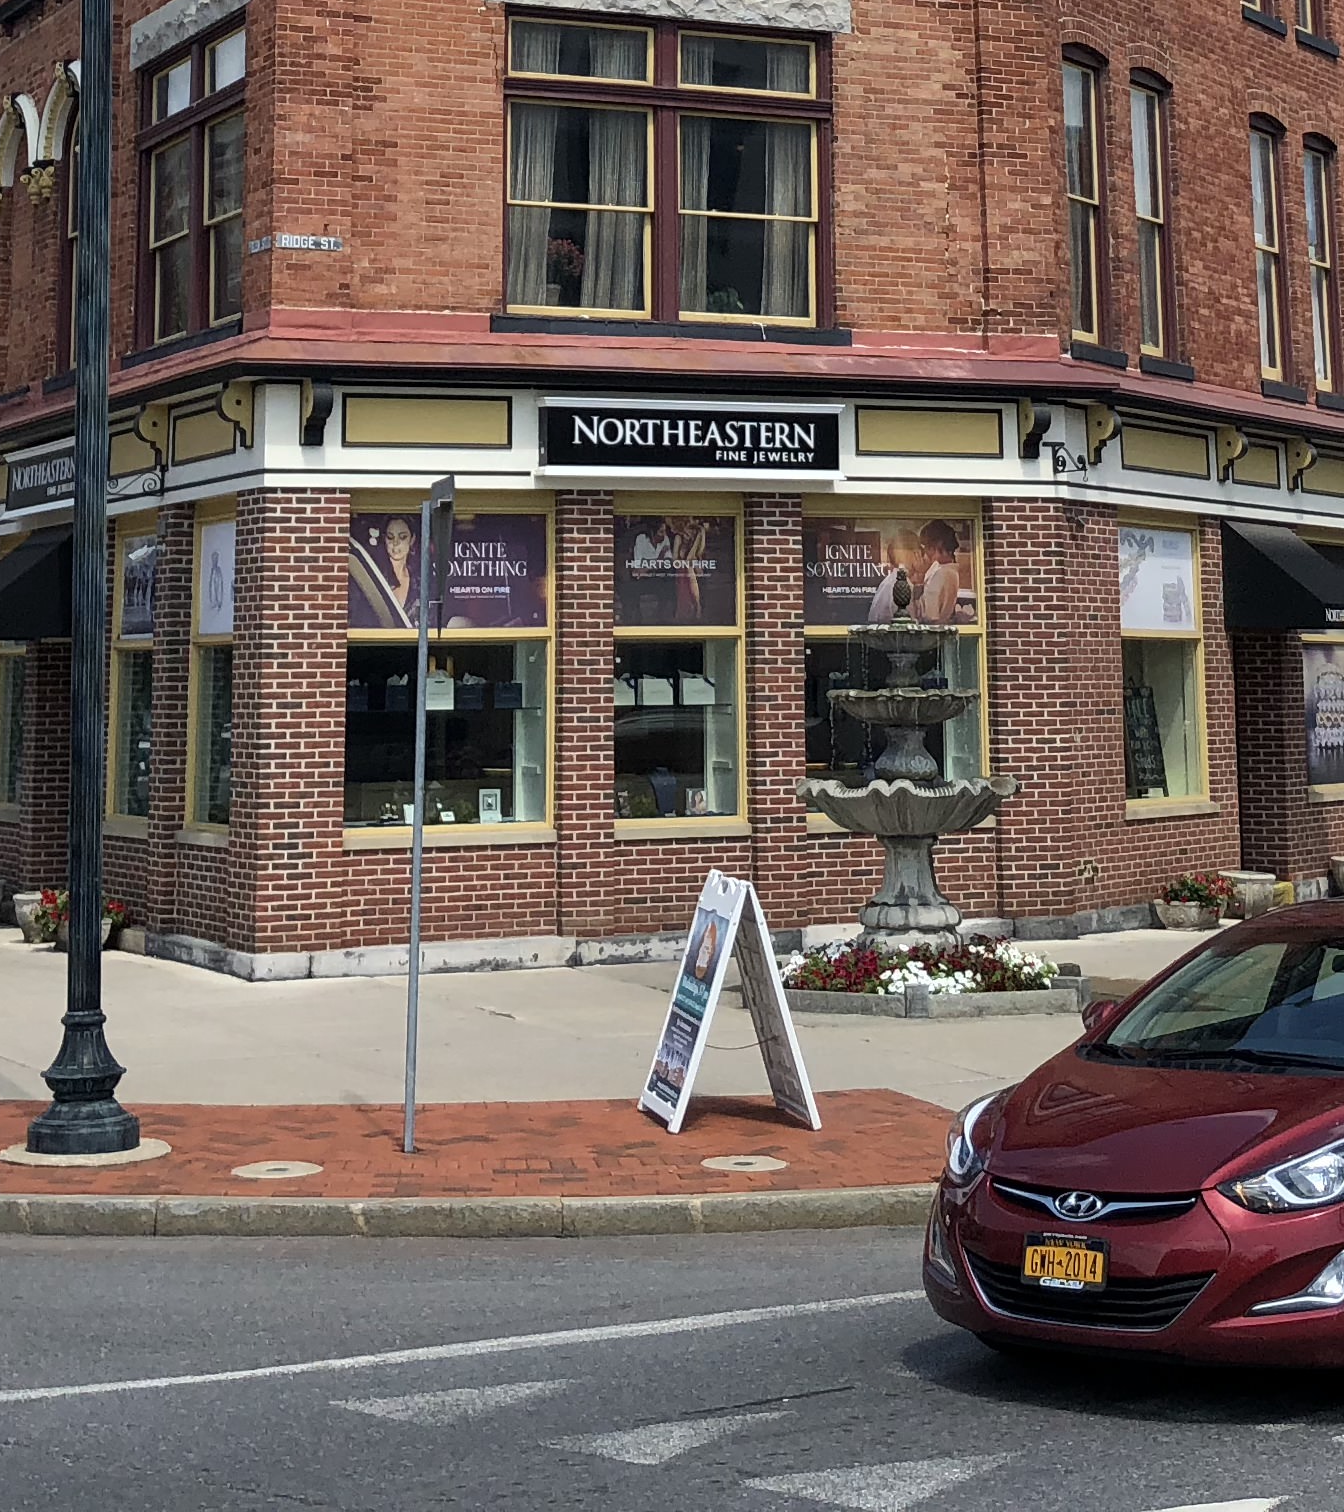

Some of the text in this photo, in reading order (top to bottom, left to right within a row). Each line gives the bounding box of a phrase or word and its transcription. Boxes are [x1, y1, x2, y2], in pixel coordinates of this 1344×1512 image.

[281, 235, 315, 249] RIDGE
[320, 235, 337, 250] ST.
[572, 415, 816, 450] NORTHEASTERN
[715, 450, 815, 464] FINE JEWELRY
[454, 542, 507, 558] IGNITE
[825, 544, 873, 560] IGNITE
[625, 559, 717, 570] HEARTS ON FIRE
[806, 561, 891, 578] SOMETHING
[449, 586, 511, 594] HEARTS ON FIRE
[822, 586, 850, 594] HEARTS
[850, 586, 861, 594] ON
